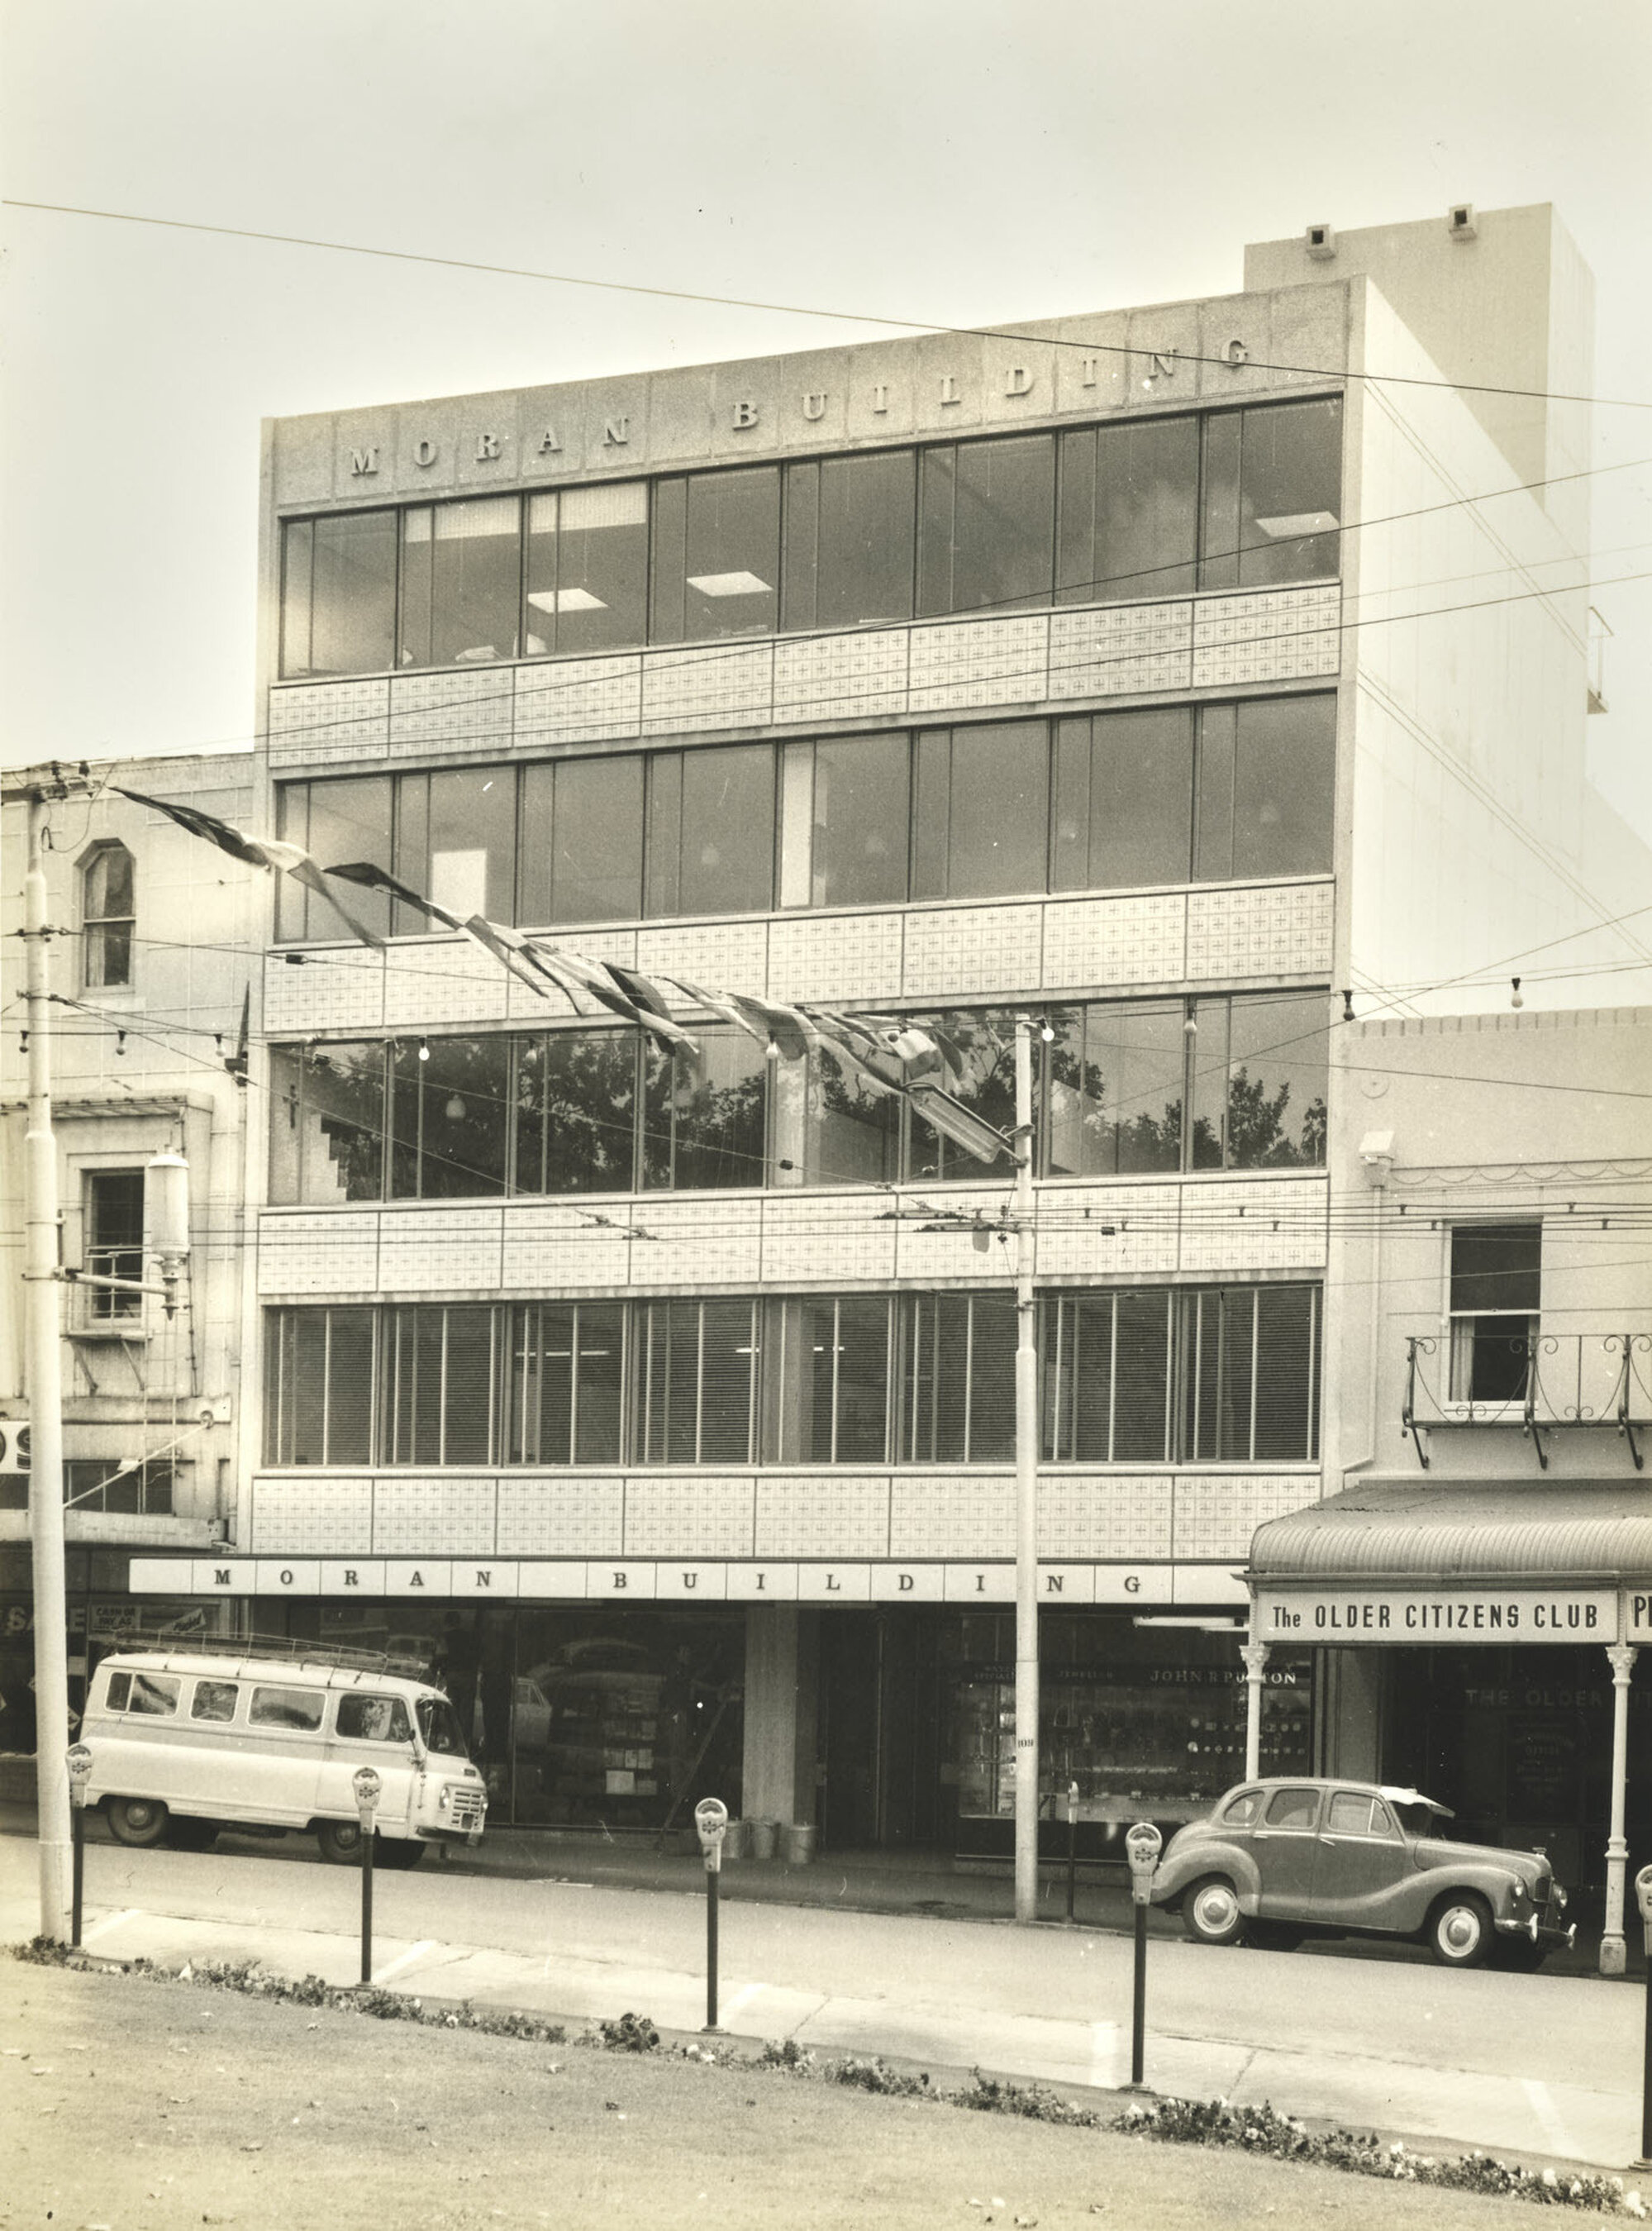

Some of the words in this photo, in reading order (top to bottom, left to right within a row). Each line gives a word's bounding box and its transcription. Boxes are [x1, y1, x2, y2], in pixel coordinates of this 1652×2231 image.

[350, 415, 630, 478] MORAN
[732, 340, 1250, 430] BUILDING
[214, 1569, 493, 1587] MORAN
[613, 1573, 1141, 1593] BUILDING
[7, 1606, 86, 1633] SE
[1273, 1606, 1302, 1628] The
[1315, 1604, 1391, 1628] OLDER
[1405, 1604, 1519, 1628] CITIZENS
[1534, 1604, 1597, 1628] CLUB
[1150, 1669, 1202, 1683] JOHN
[1223, 1670, 1296, 1685] PUTON
